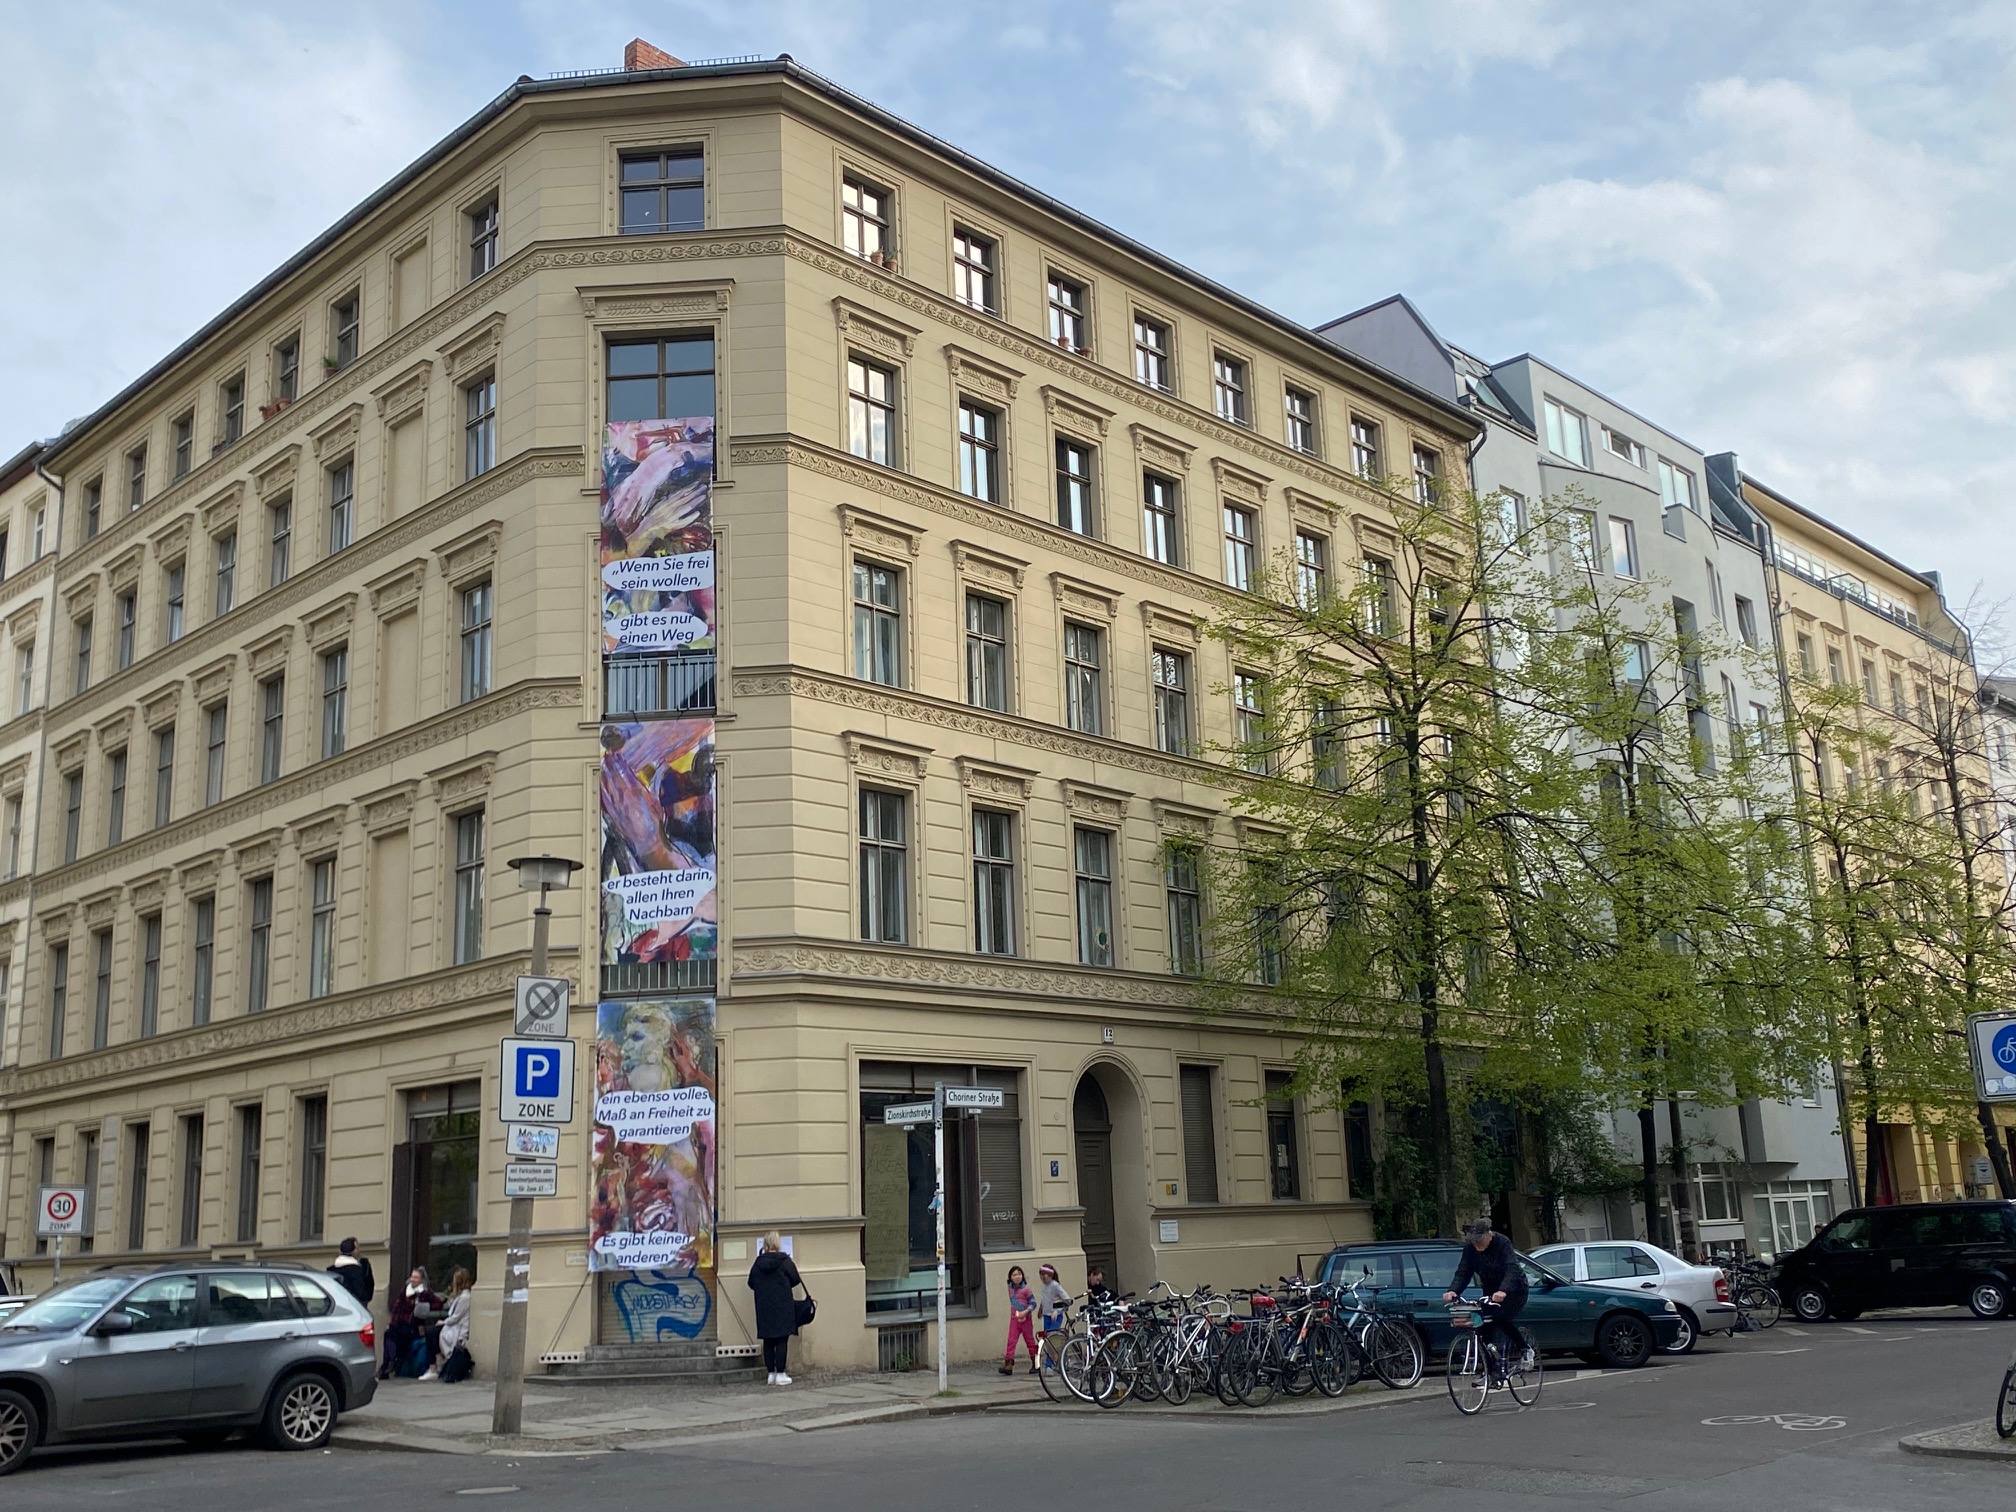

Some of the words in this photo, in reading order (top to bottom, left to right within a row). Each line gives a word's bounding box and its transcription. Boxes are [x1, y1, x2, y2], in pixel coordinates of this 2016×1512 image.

[663, 558, 684, 570] Sie
[688, 557, 710, 569] frei
[621, 577, 648, 590] sein
[652, 574, 701, 588] wollen,
[620, 614, 648, 631] gibt
[652, 616, 667, 626] es
[670, 614, 694, 625] nur
[620, 632, 657, 644] einen
[661, 629, 694, 643] Weg
[607, 880, 620, 890] er
[623, 872, 672, 888] besteht
[675, 868, 713, 882] darin,
[626, 891, 657, 905] allen
[661, 889, 694, 901] Ihren
[629, 904, 694, 921] Nachbarn
[528, 1021, 555, 1033] ZONE
[526, 1054, 550, 1091] P
[602, 1093, 620, 1105] ein
[624, 1091, 670, 1103] ebenso
[673, 1088, 708, 1100] volles
[948, 1091, 977, 1102] Choriner
[978, 1092, 1000, 1105] Straße
[518, 1103, 555, 1118] ZONE
[598, 1108, 627, 1121] Maß
[629, 1110, 645, 1120] an
[648, 1105, 694, 1119] Freiheit
[696, 1107, 711, 1117] zu
[887, 1106, 932, 1121] Zionskirchstraße
[619, 1124, 690, 1141] garantieren
[53, 1199, 71, 1214] 30
[602, 1235, 616, 1247] Es
[619, 1234, 645, 1250] gibt
[648, 1231, 691, 1246] keinen
